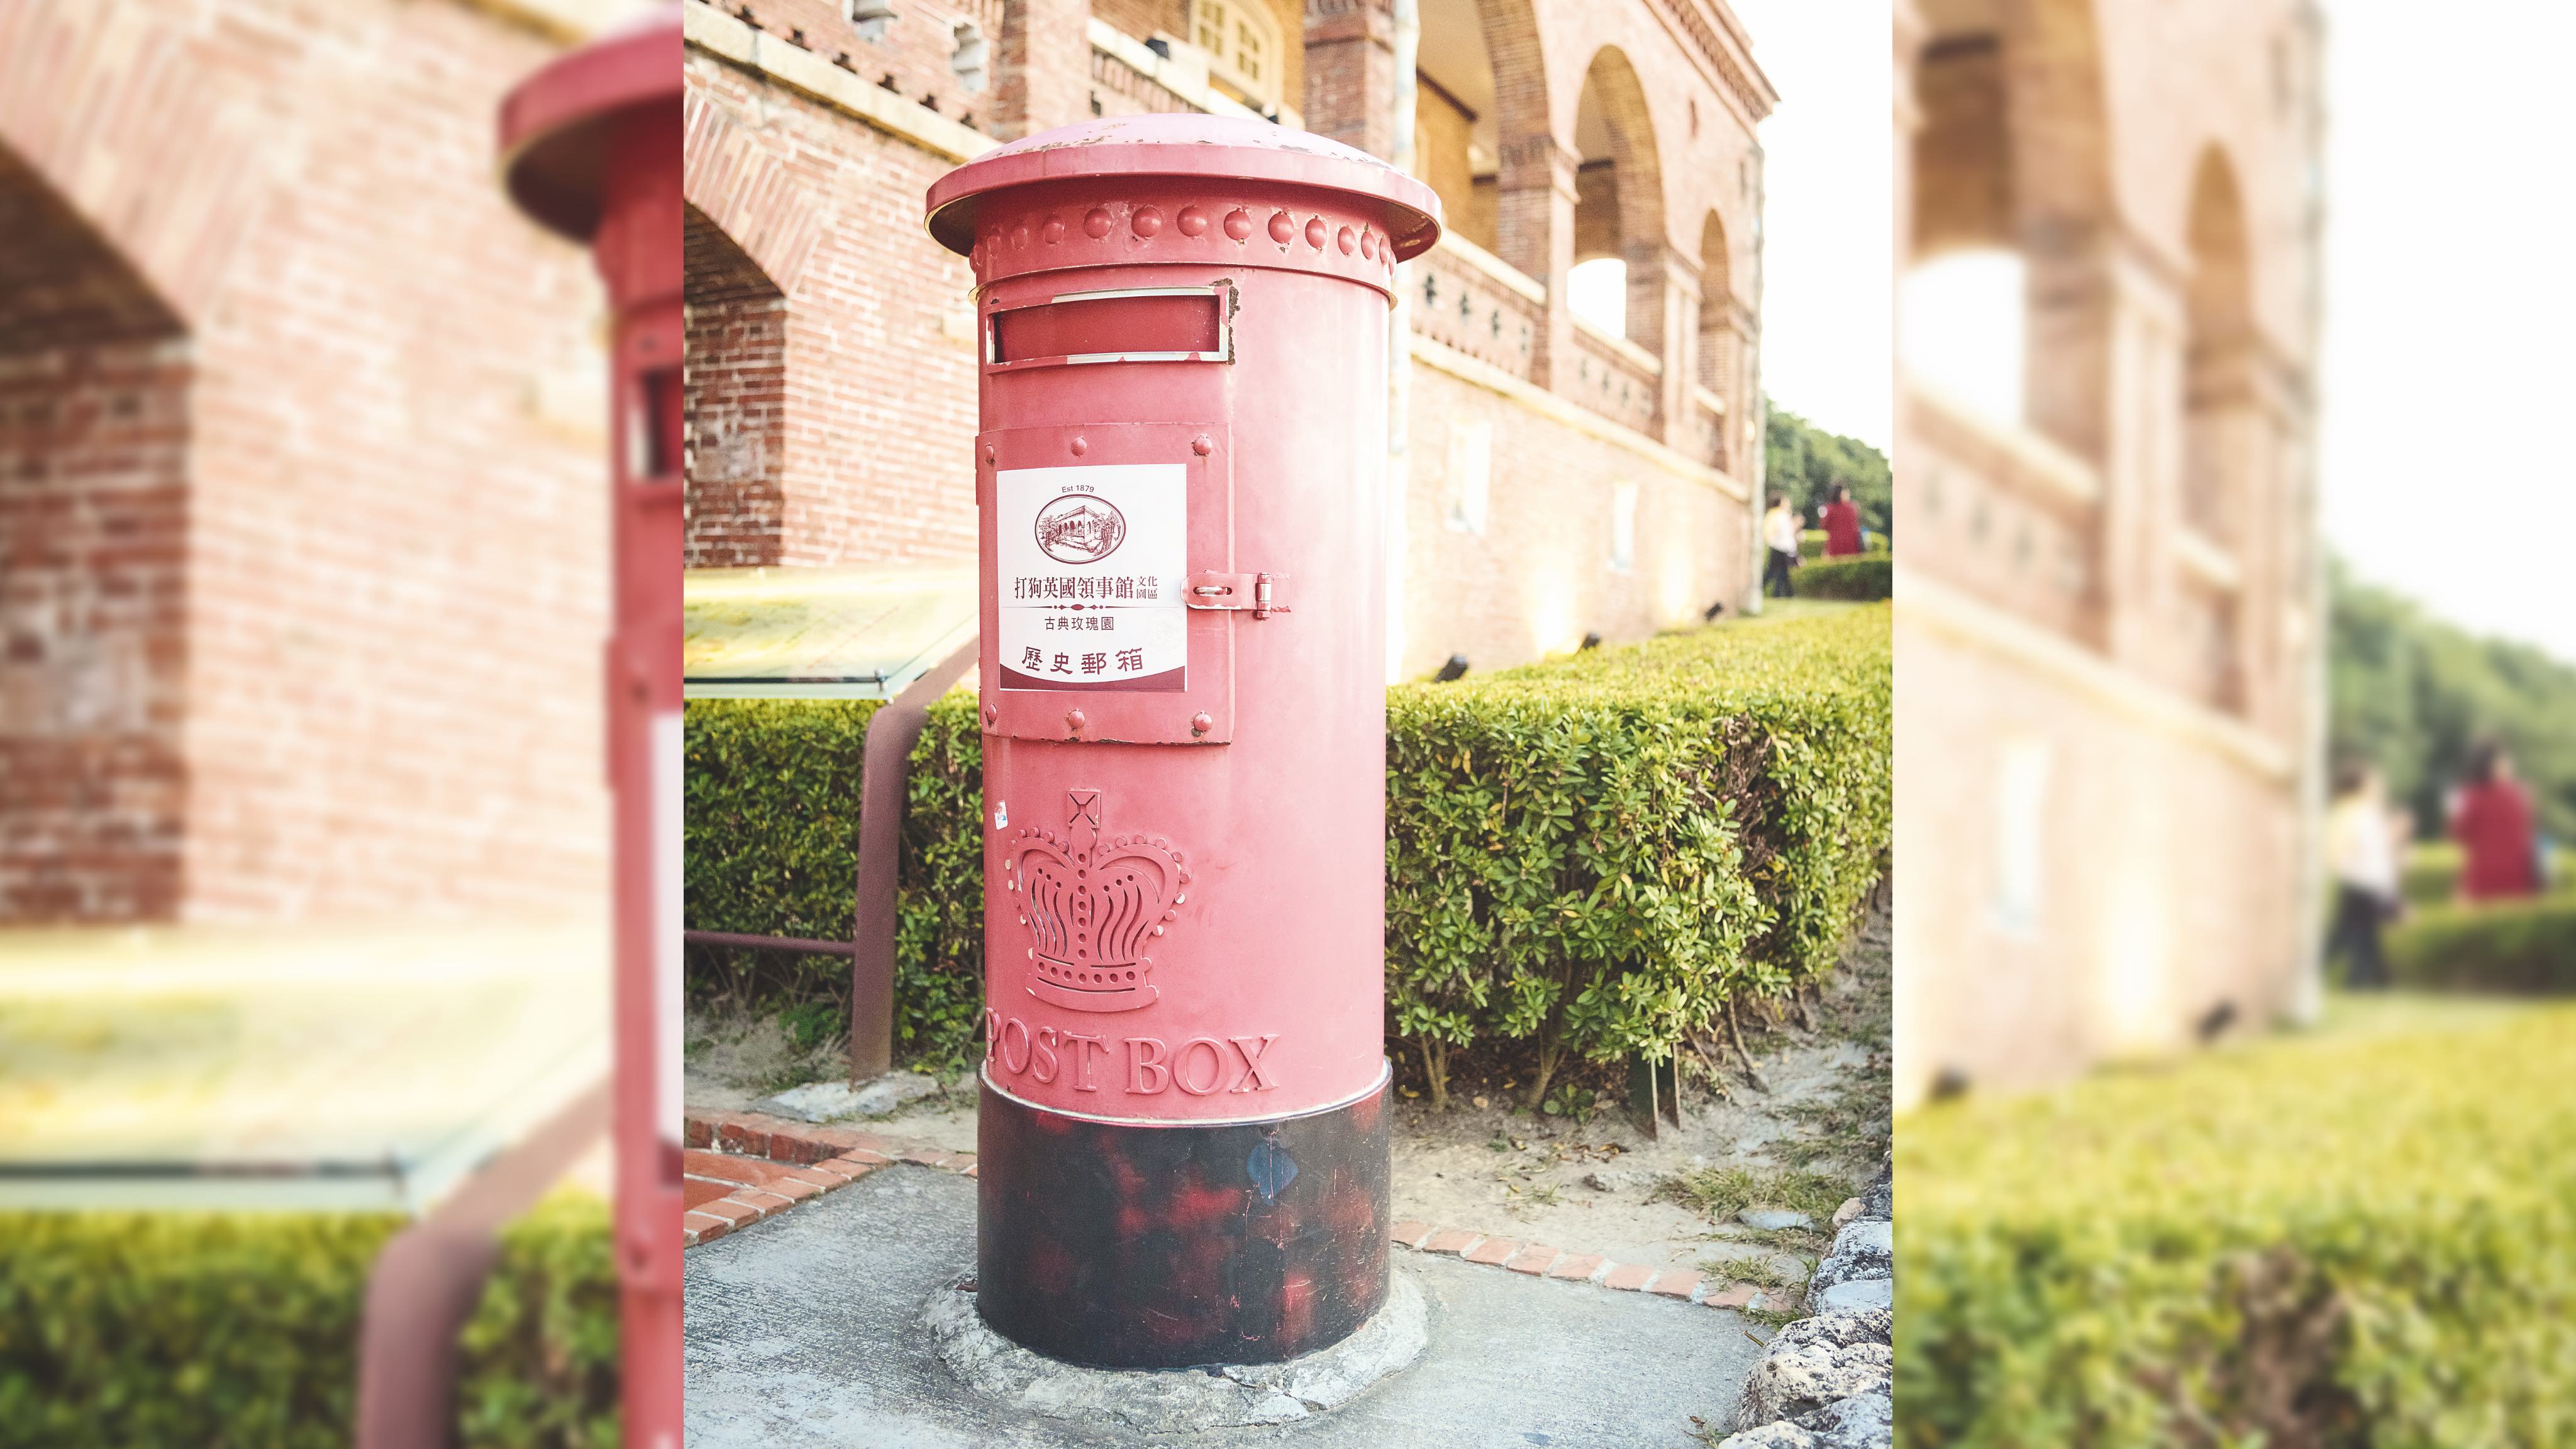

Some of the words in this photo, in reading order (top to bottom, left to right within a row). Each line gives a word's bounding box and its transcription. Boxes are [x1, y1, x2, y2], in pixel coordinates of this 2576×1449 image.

[1076, 484, 1094, 492] 1879
[1014, 576, 1134, 599] 打狗英國領事館
[1136, 576, 1158, 587] 文化
[1136, 588, 1158, 599] 園區
[1045, 616, 1114, 631] 古典玫瑰園
[1022, 647, 1143, 675] 歷史郵箱
[985, 1007, 1110, 1092] POST
[1123, 1032, 1280, 1096] BOX
